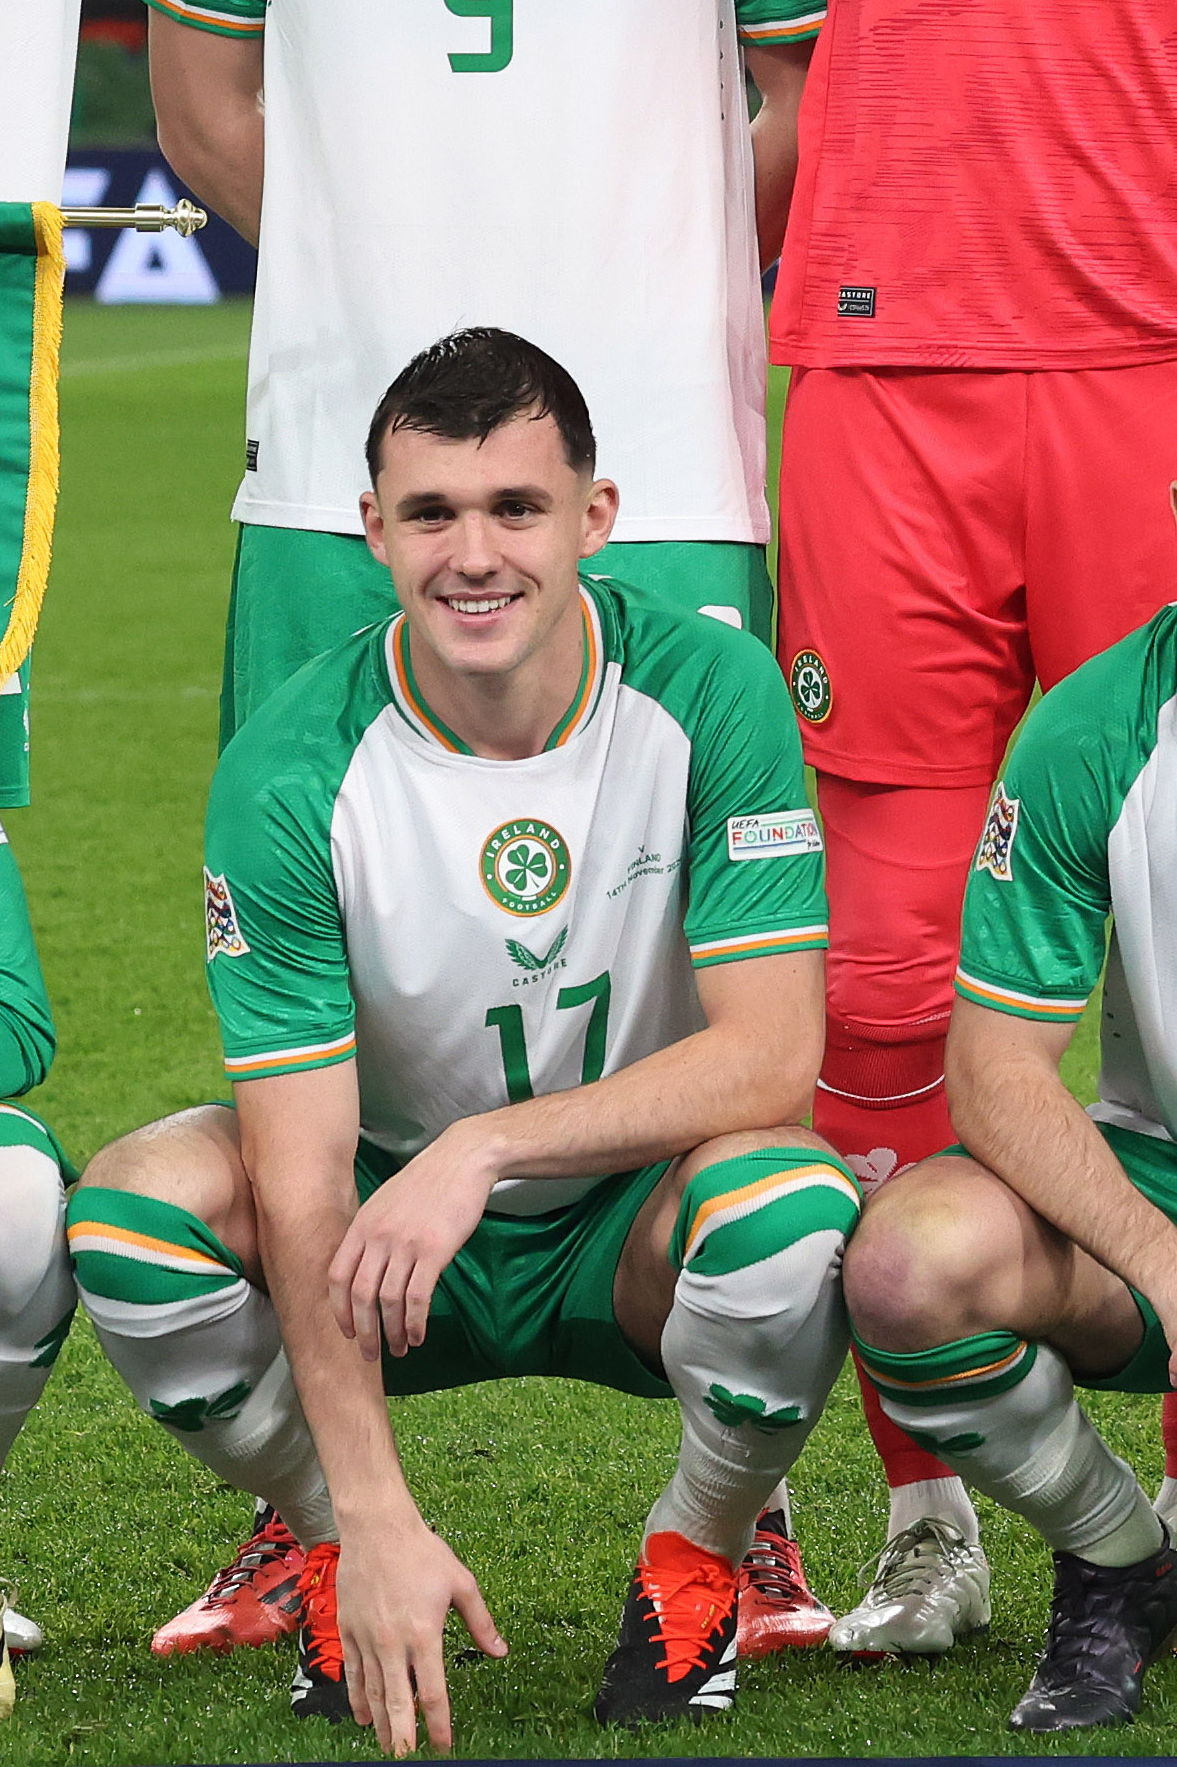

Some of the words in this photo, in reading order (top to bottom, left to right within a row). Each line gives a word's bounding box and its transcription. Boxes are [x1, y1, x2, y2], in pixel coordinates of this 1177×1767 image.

[731, 819, 759, 830] UEFA
[486, 823, 560, 858] IRELAND
[501, 891, 557, 911] FOOTBALL
[512, 958, 568, 987] CASTORE
[484, 969, 612, 1105] 17
